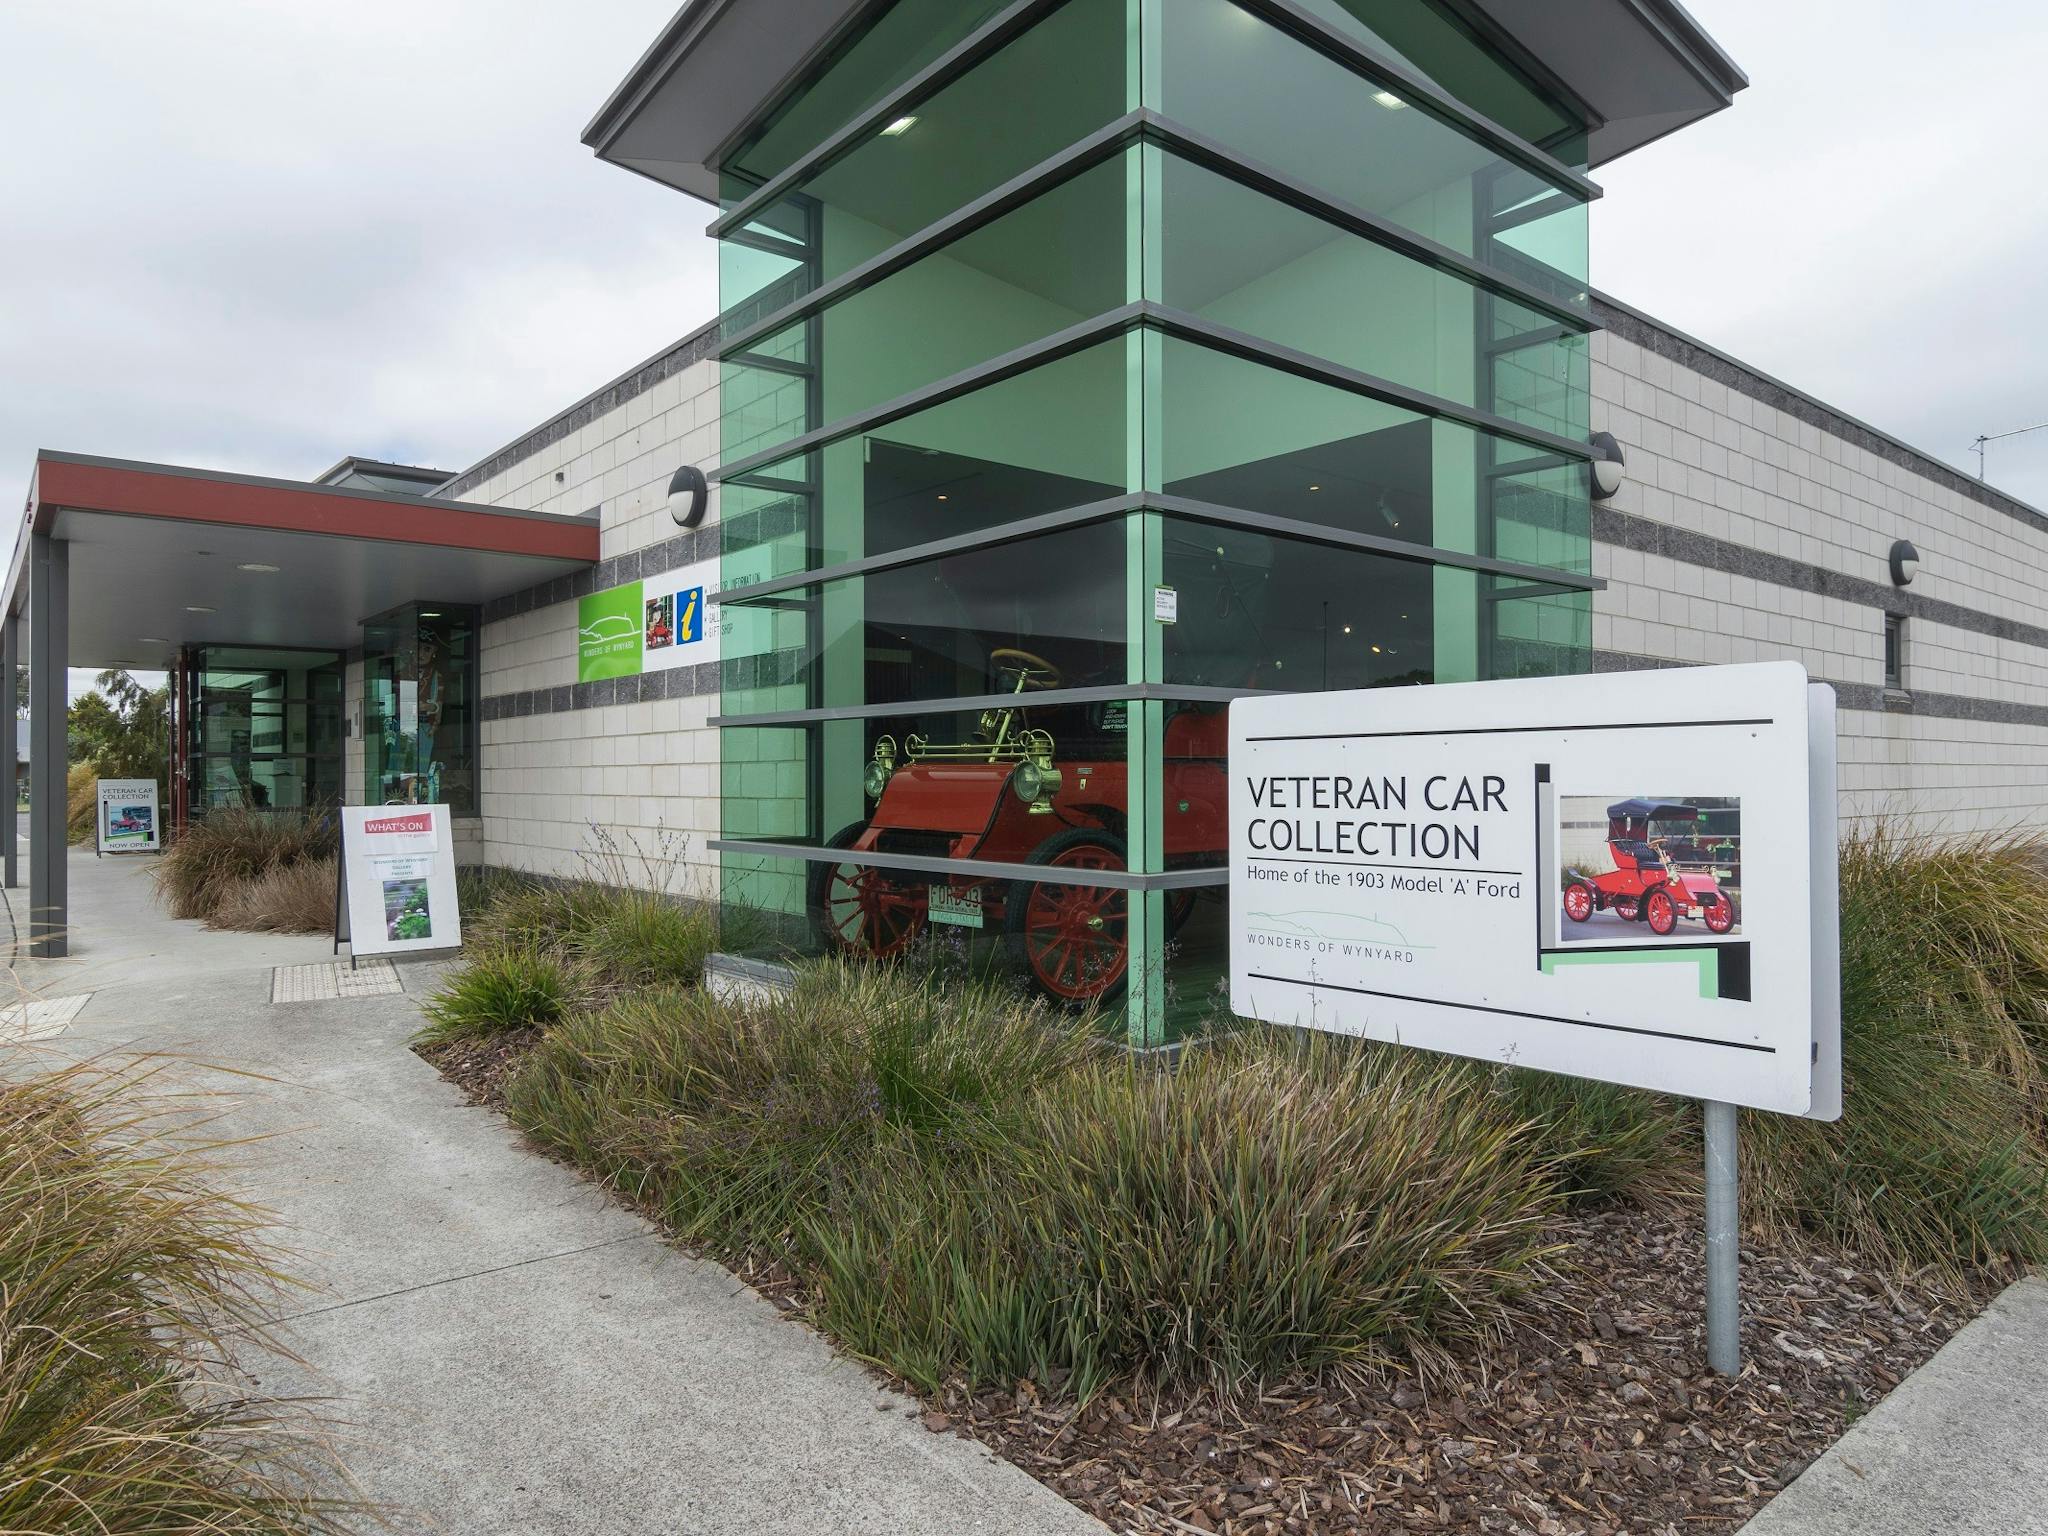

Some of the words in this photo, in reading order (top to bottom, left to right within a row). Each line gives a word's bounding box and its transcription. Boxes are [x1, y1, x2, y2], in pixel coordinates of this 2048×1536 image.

[709, 609, 728, 623] GALLRY
[1247, 776, 1407, 811] VETERAN
[1423, 775, 1509, 812] CAR
[367, 822, 406, 832] WHAT'S
[408, 822, 424, 831] ON
[1247, 818, 1480, 861] COLLECTION
[1247, 865, 1289, 883] Home
[1293, 868, 1309, 883] of
[1314, 869, 1341, 886] the
[1347, 872, 1385, 889] 1903
[1390, 874, 1444, 894] Model
[1450, 878, 1470, 895] 'A'
[1476, 880, 1521, 899] Ford
[1247, 934, 1311, 951] WONDERS
[1318, 942, 1335, 953] OF
[1342, 944, 1413, 963] WYNYARD
